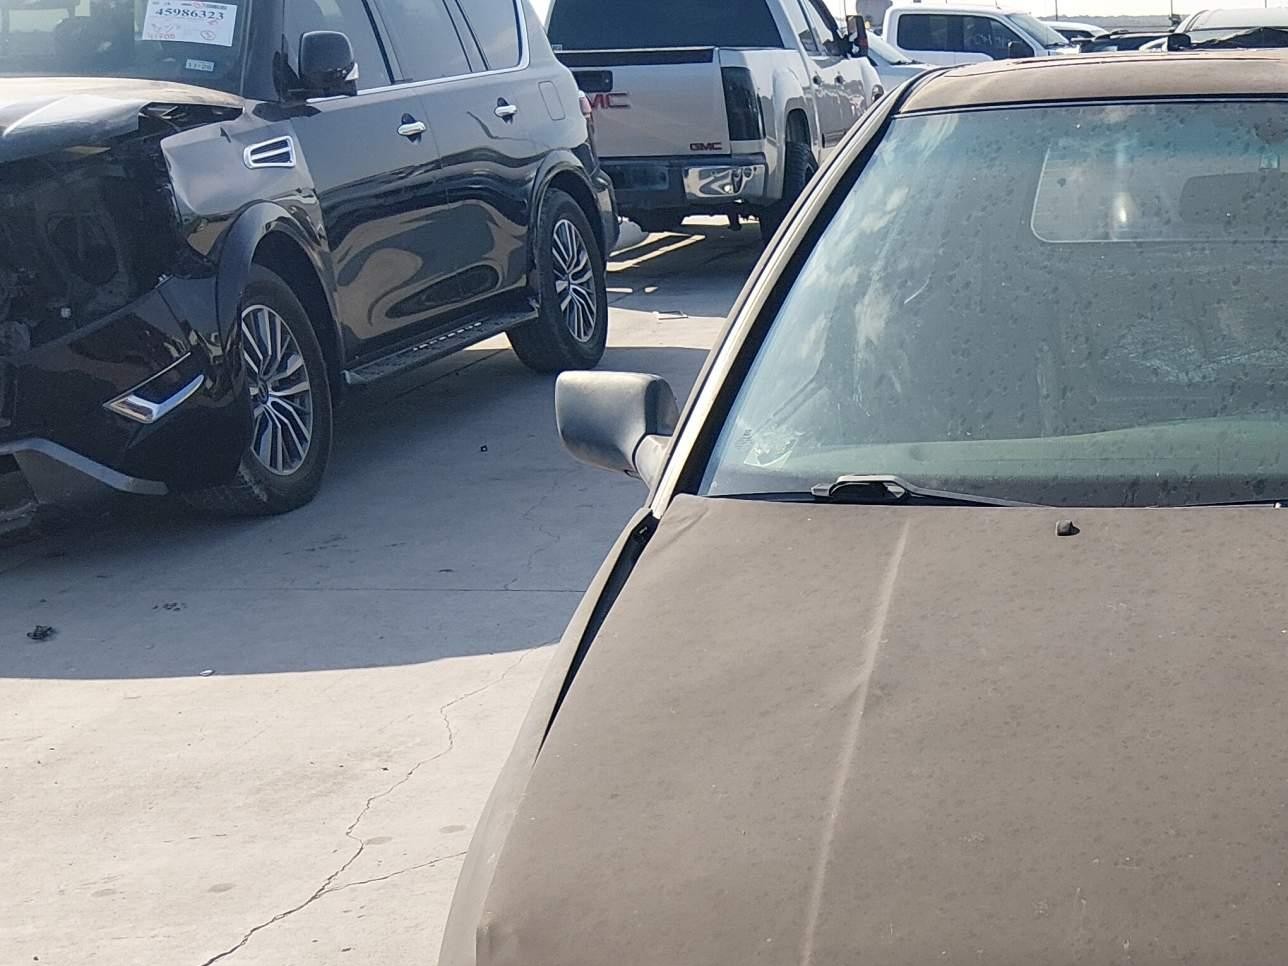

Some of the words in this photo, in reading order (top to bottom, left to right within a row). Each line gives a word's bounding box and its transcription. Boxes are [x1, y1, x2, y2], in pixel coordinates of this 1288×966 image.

[155, 8, 224, 21] 45986323
[586, 92, 632, 109] MC
[689, 142, 722, 151] GMC
